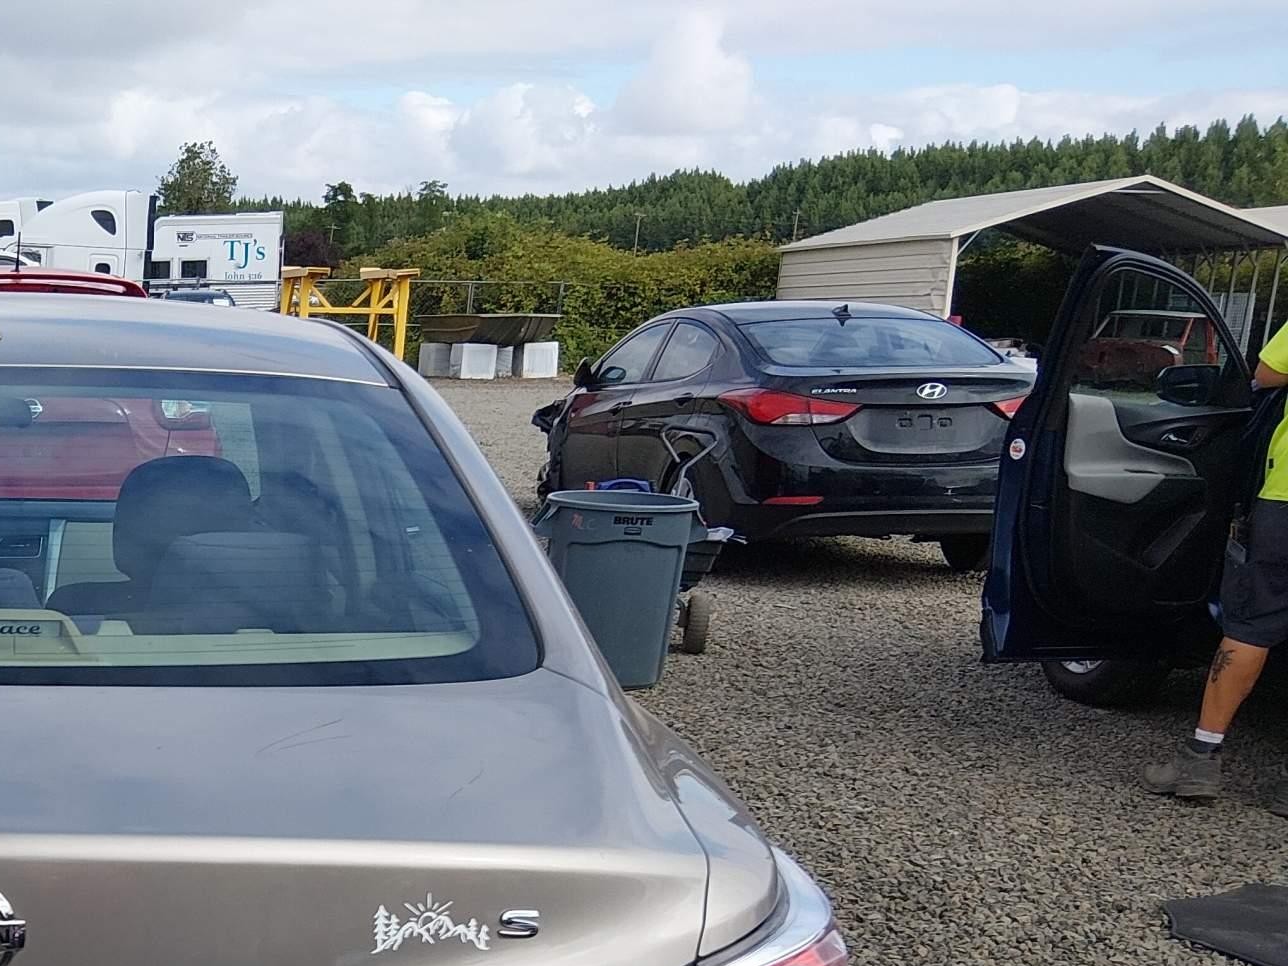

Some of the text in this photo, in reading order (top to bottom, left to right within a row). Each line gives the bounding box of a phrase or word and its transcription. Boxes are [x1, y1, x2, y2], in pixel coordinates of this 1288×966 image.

[223, 239, 265, 269] TJ's
[224, 271, 245, 280] John
[613, 516, 654, 526] BRUTE
[497, 909, 540, 938] S
